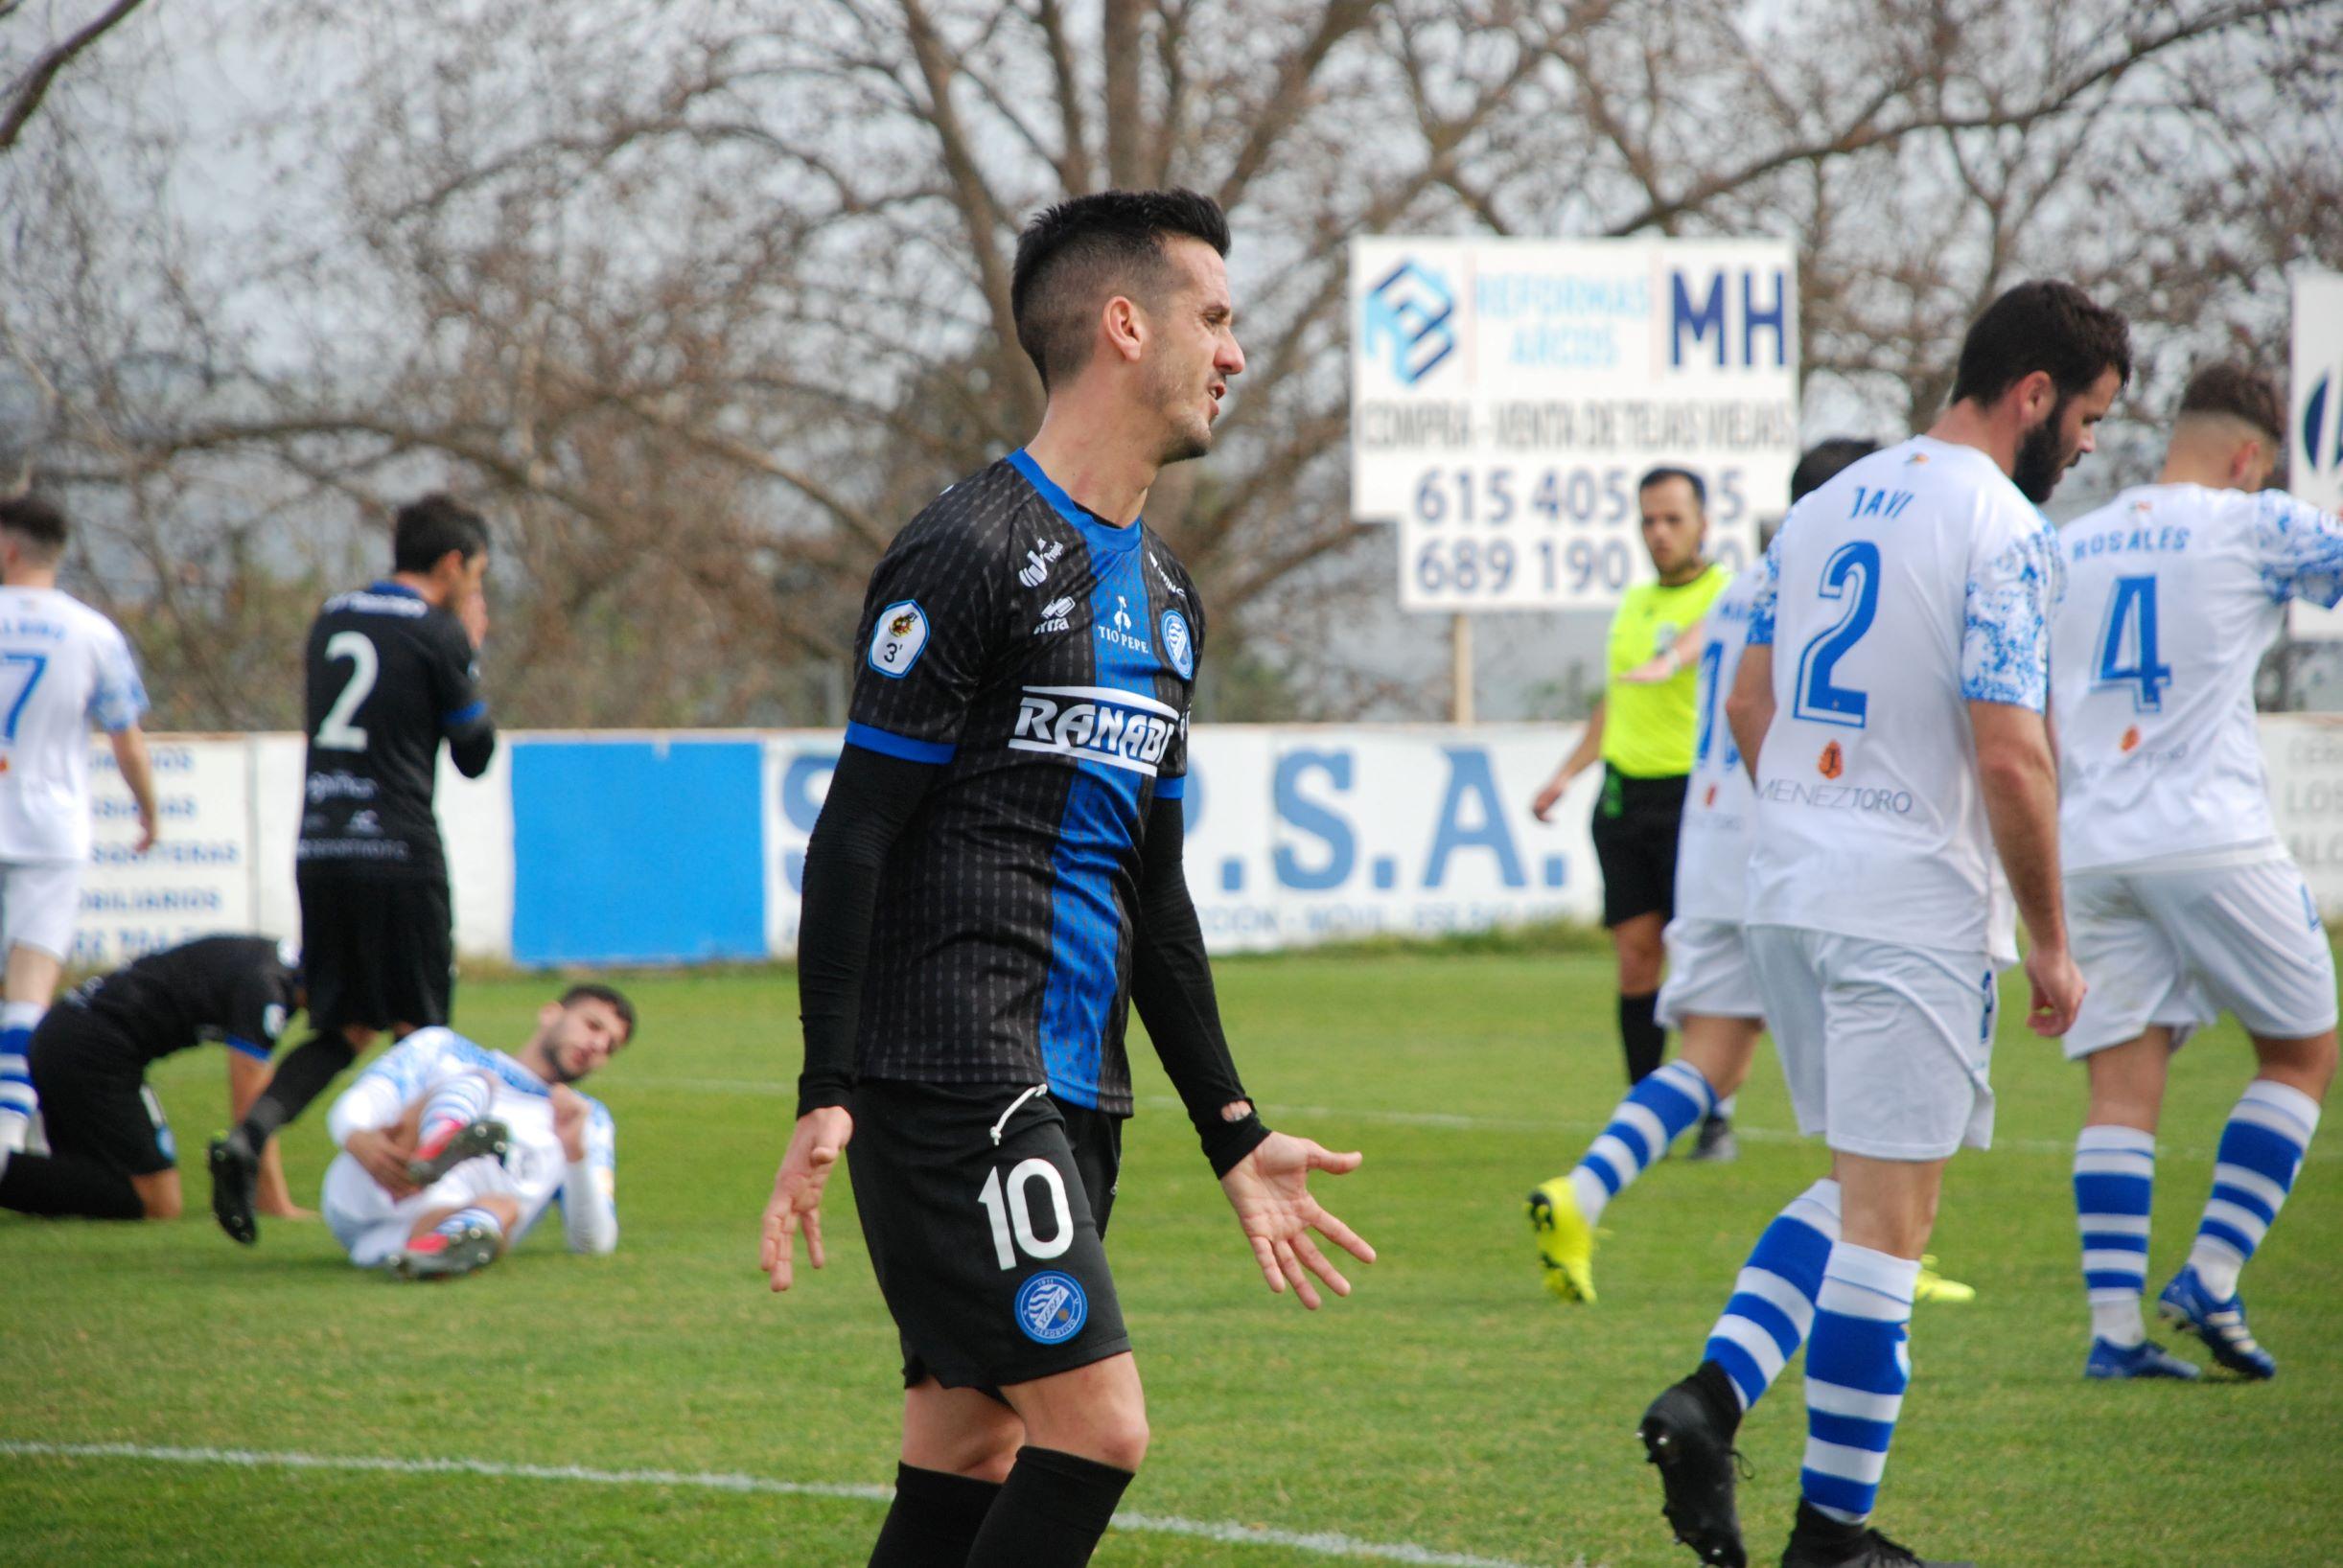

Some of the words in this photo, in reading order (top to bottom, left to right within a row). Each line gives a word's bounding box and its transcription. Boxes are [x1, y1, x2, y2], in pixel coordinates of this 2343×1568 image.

[1672, 269, 1786, 370] MH
[1361, 398, 1472, 450] COMPRA
[1495, 398, 1574, 450] VENTA
[1584, 398, 1616, 450] DE
[1416, 467, 1517, 525] 615
[1531, 467, 1630, 525] 405
[1416, 538, 1517, 594] 689
[1537, 538, 1633, 594] 190
[2073, 526, 2191, 562] ROSALES
[1098, 625, 1120, 643] TIO
[1120, 633, 1149, 654] PEPE
[1793, 540, 1881, 728] 2
[2089, 575, 2172, 714] 4
[313, 630, 380, 752] 2
[978, 1158, 1074, 1271] 10
